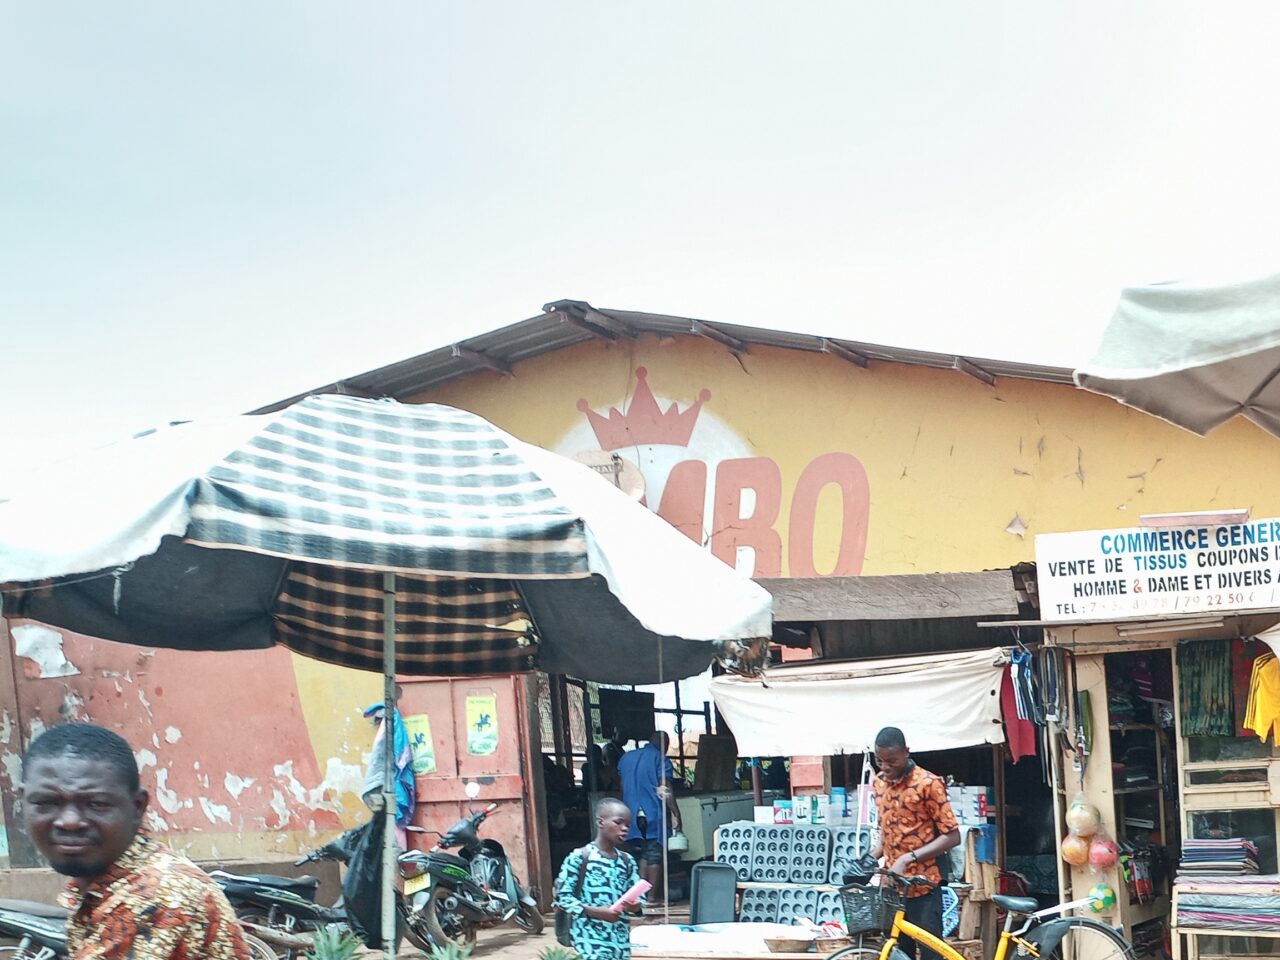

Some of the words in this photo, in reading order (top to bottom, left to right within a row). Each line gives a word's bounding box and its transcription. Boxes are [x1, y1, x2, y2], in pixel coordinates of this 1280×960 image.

[1101, 528, 1209, 555] COMMERCE
[1048, 558, 1096, 577] VENTE
[1105, 556, 1123, 573] DE
[1133, 552, 1187, 571] TISSUS
[1197, 546, 1269, 568] COUPONS
[1073, 579, 1128, 598] HOMME
[1133, 579, 1143, 594] &
[1148, 574, 1189, 593] DAME
[1195, 571, 1212, 590] ET
[1218, 566, 1272, 589] DIVERS
